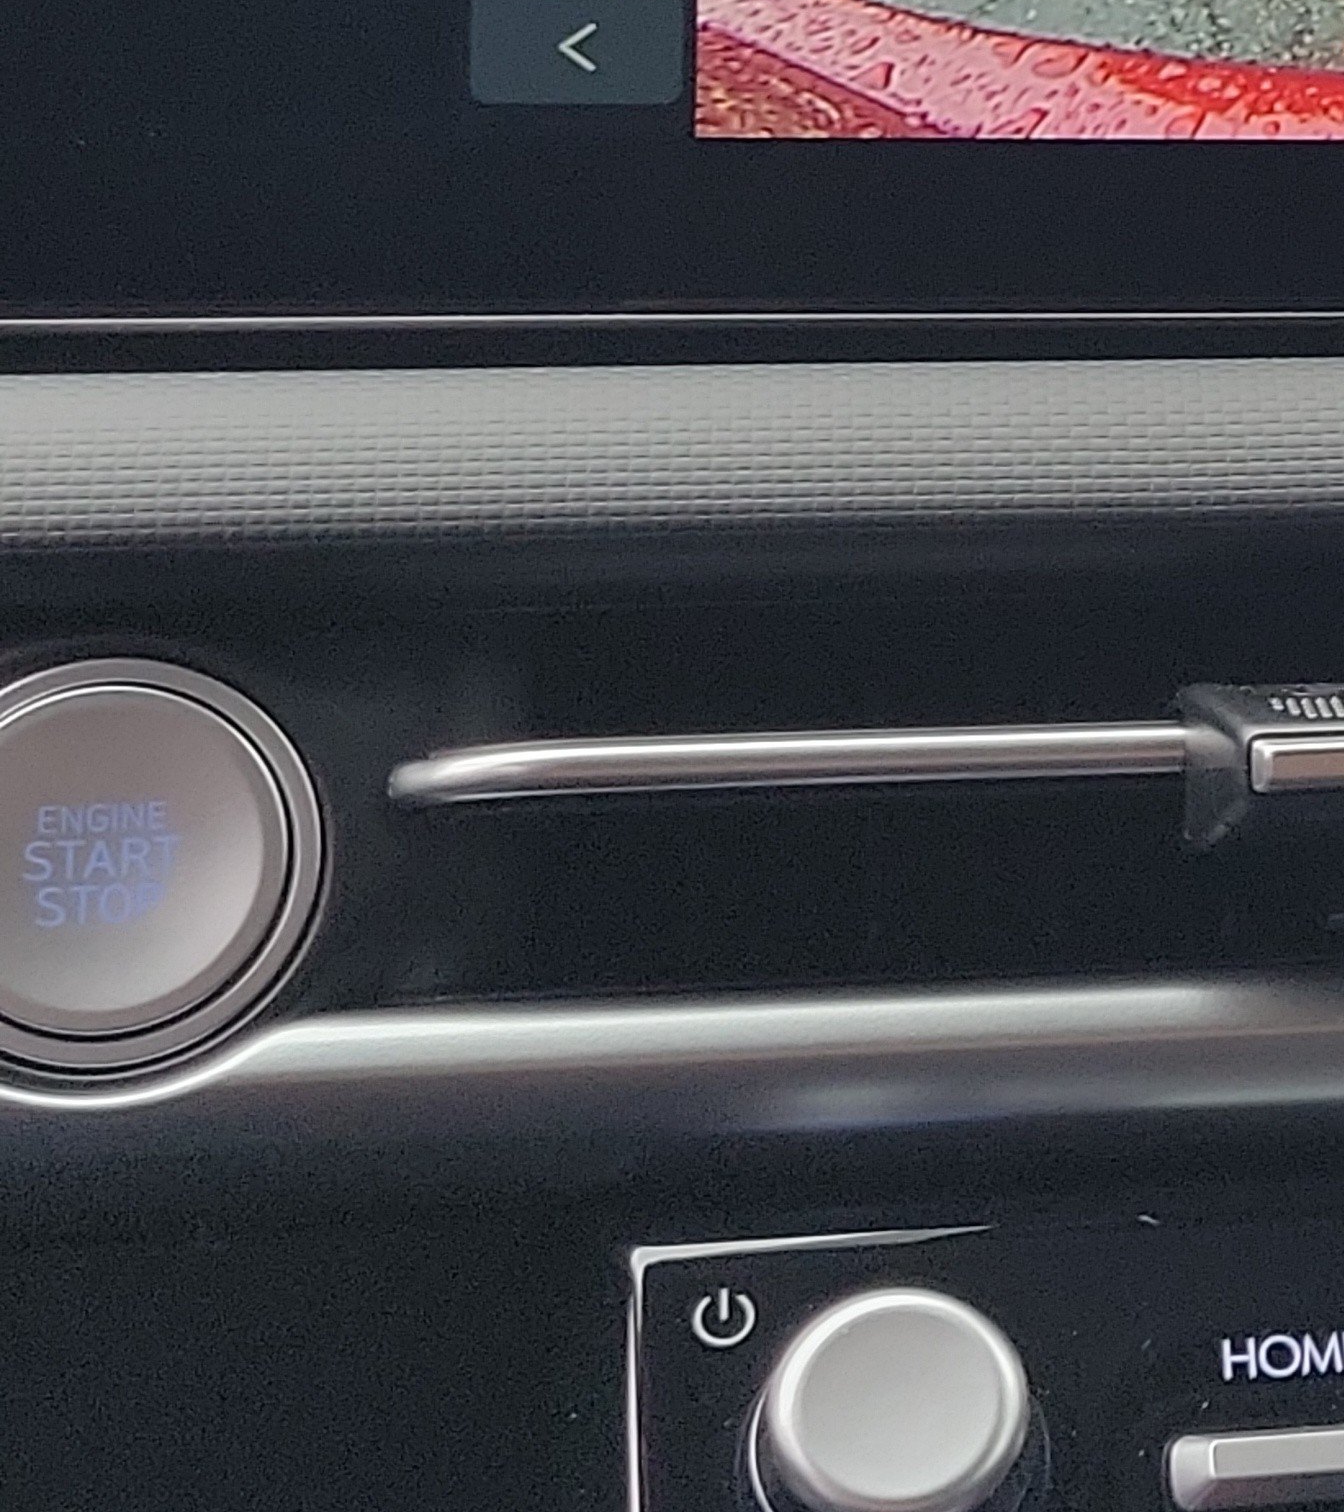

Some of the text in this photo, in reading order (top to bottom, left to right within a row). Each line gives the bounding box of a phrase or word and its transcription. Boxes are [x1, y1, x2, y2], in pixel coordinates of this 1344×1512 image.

[36, 800, 167, 835] ENGINE
[23, 834, 180, 882] START
[35, 881, 167, 928] STOP
